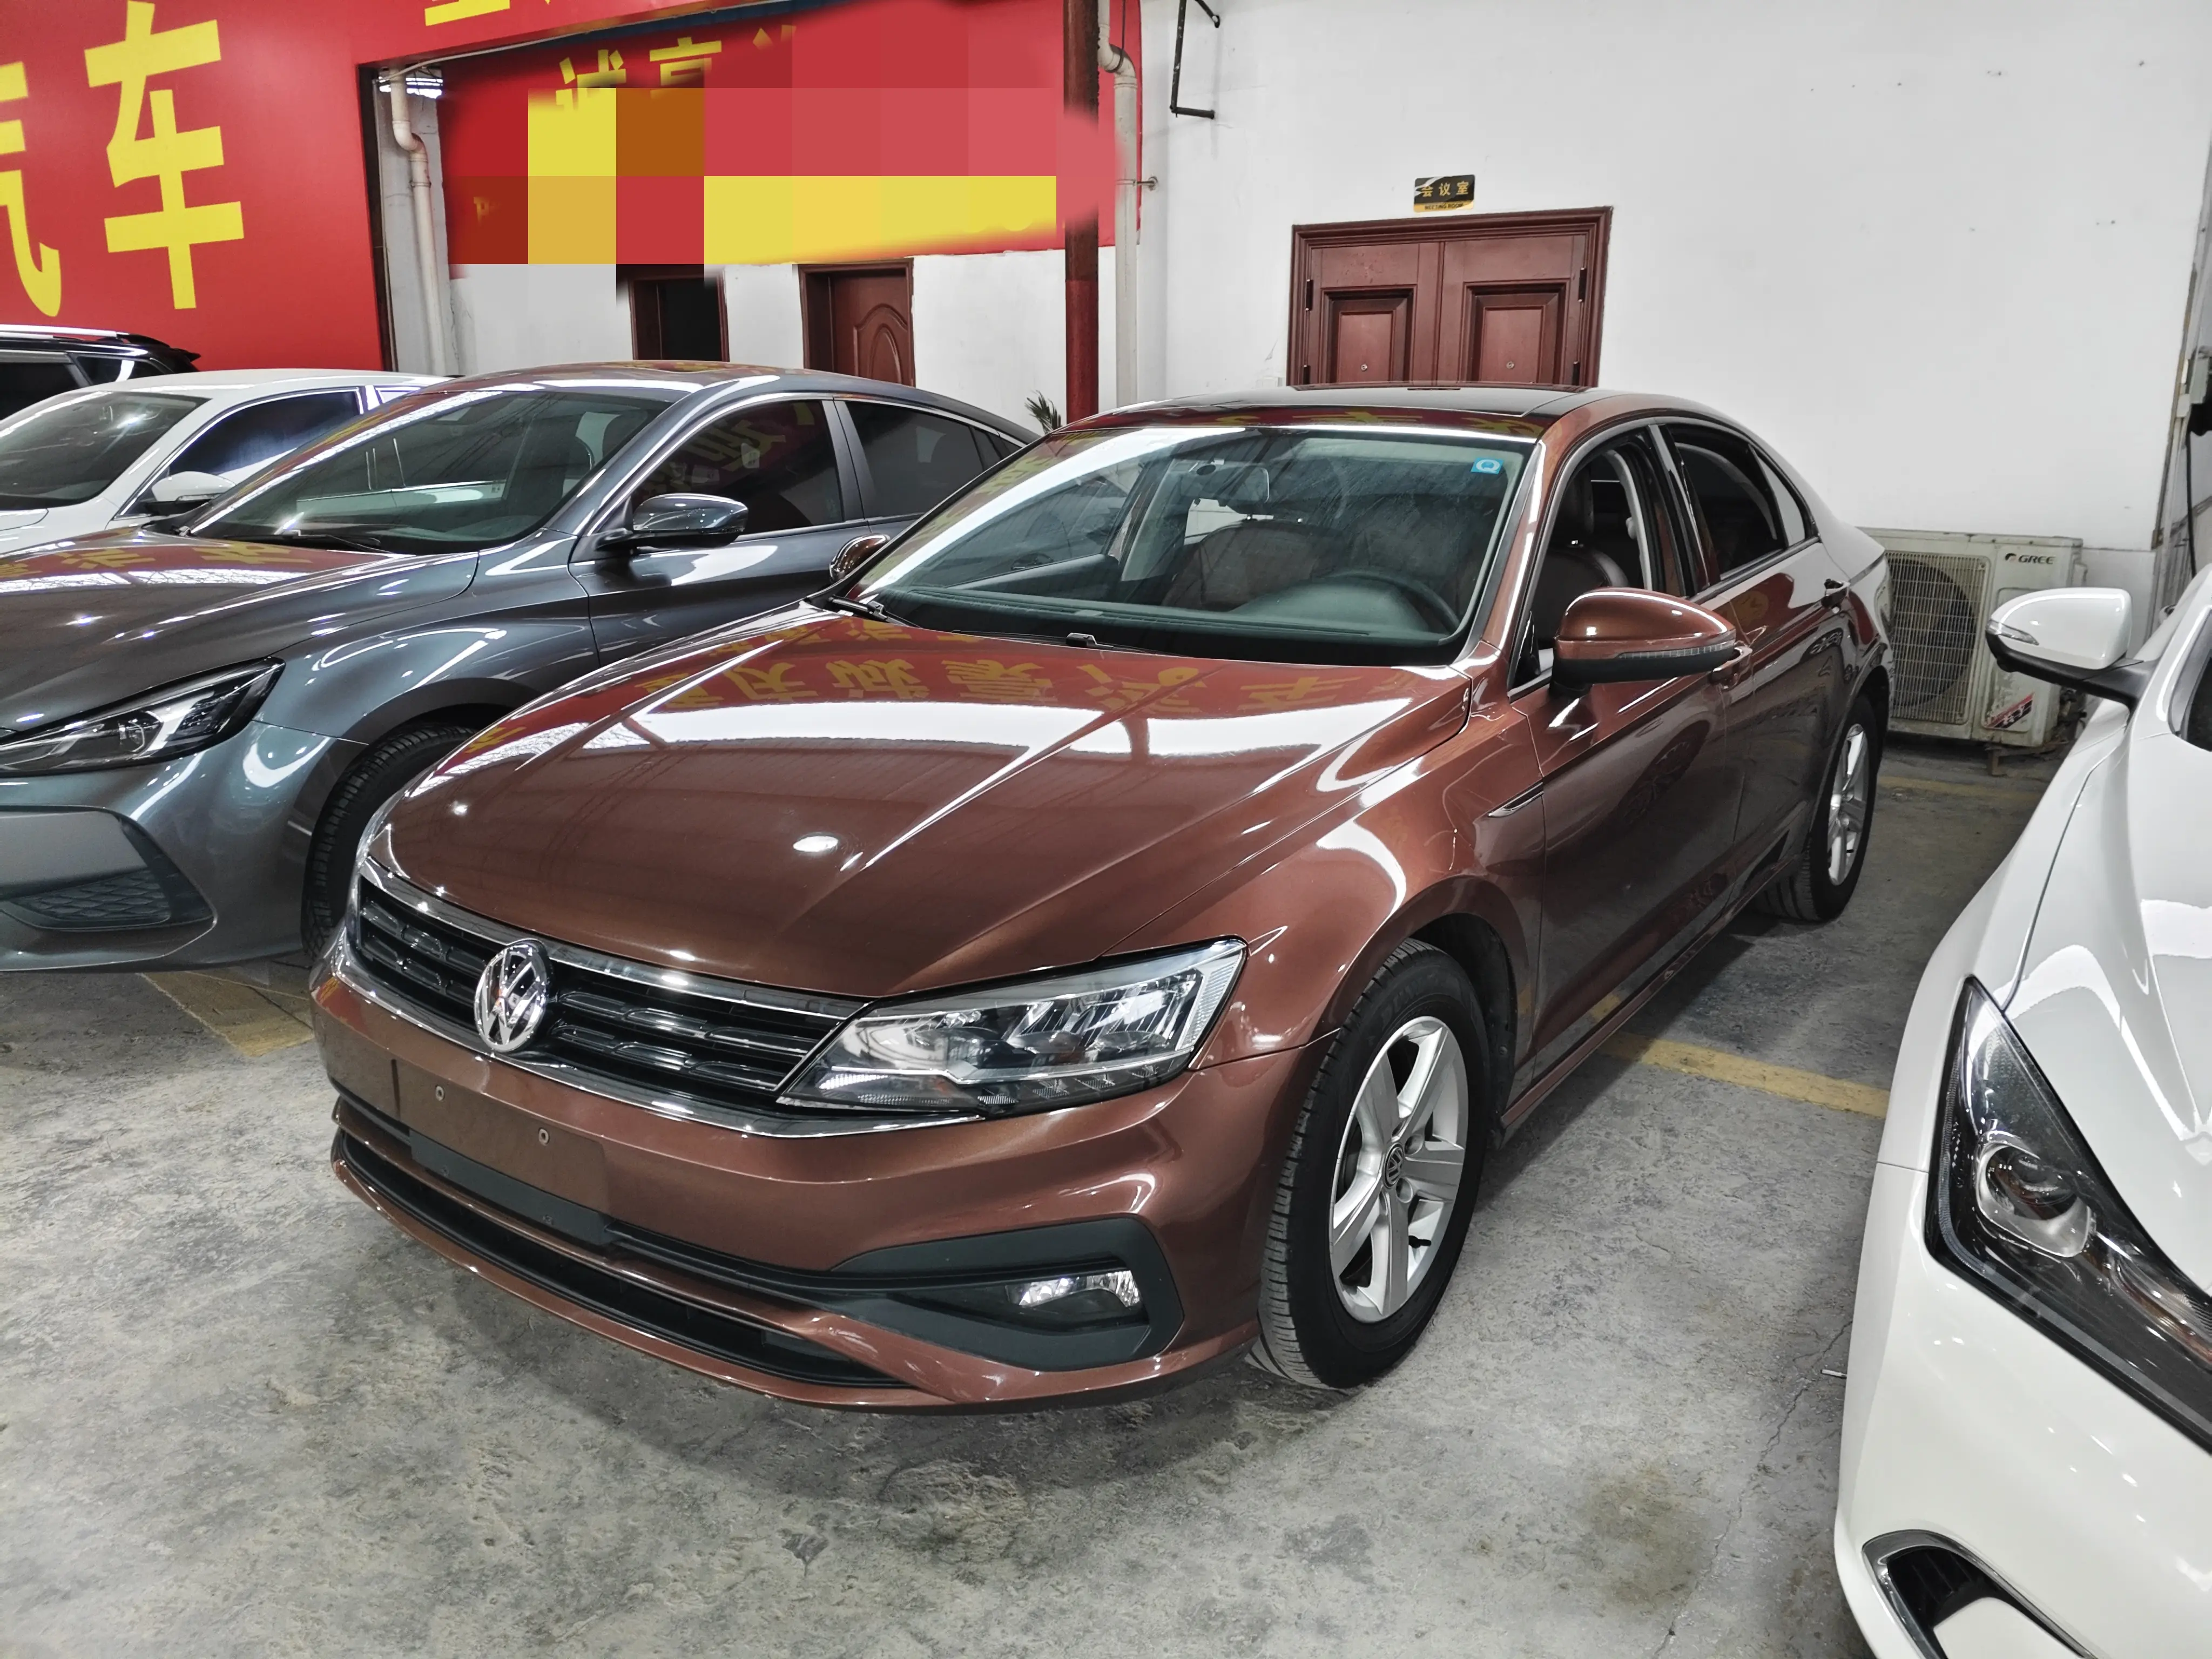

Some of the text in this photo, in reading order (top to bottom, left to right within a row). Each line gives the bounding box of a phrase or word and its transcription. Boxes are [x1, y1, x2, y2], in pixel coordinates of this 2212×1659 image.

[1421, 180, 1469, 198] 会议室
[2018, 555, 2056, 565] GREE
